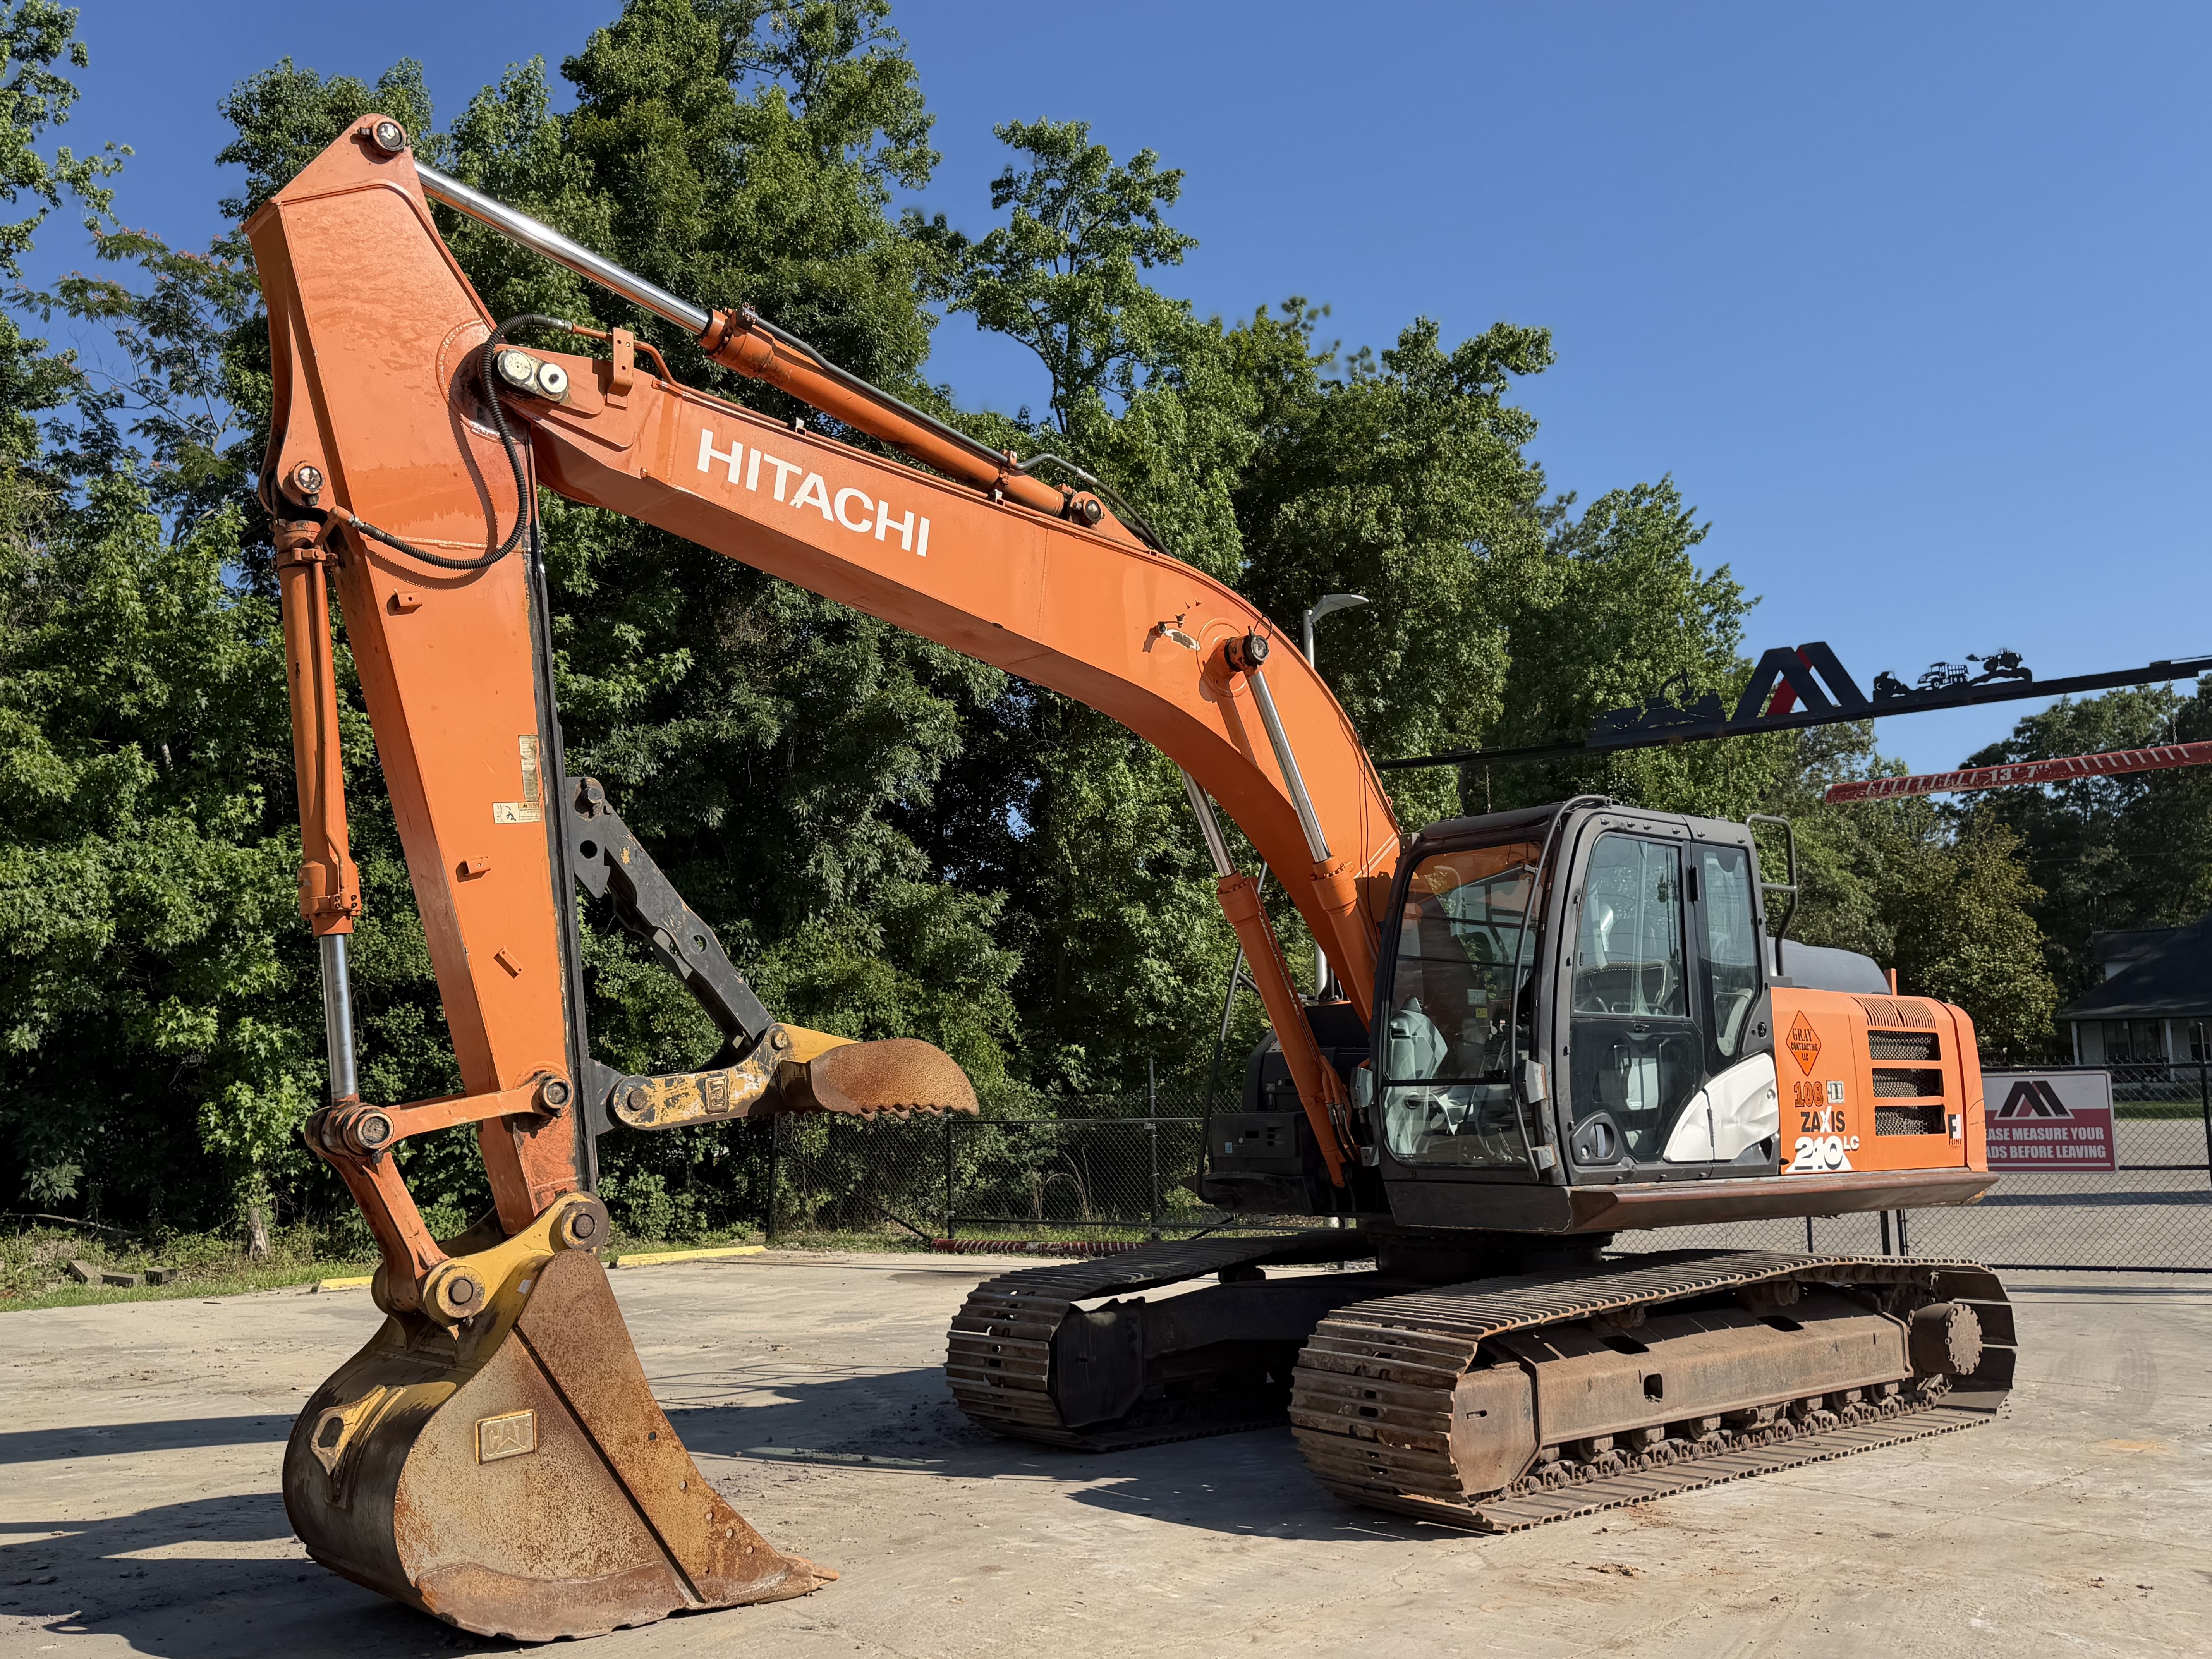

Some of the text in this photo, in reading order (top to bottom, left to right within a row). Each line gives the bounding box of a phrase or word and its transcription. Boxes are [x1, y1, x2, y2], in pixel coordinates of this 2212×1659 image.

[697, 428, 930, 557] HITACHI
[1989, 767, 2019, 782] 13'
[1792, 1028, 1812, 1042] GRAY
[1791, 1042, 1818, 1052] CONTRACTING
[1794, 1081, 1824, 1107] 108
[1800, 1106, 1846, 1133] ZAXIS
[1986, 1127, 2104, 1141] ASE MEASURE YOUR
[2009, 1145, 2054, 1158] BEFORE
[2056, 1145, 2106, 1158] LEAVING
[485, 1419, 531, 1456] CAT
